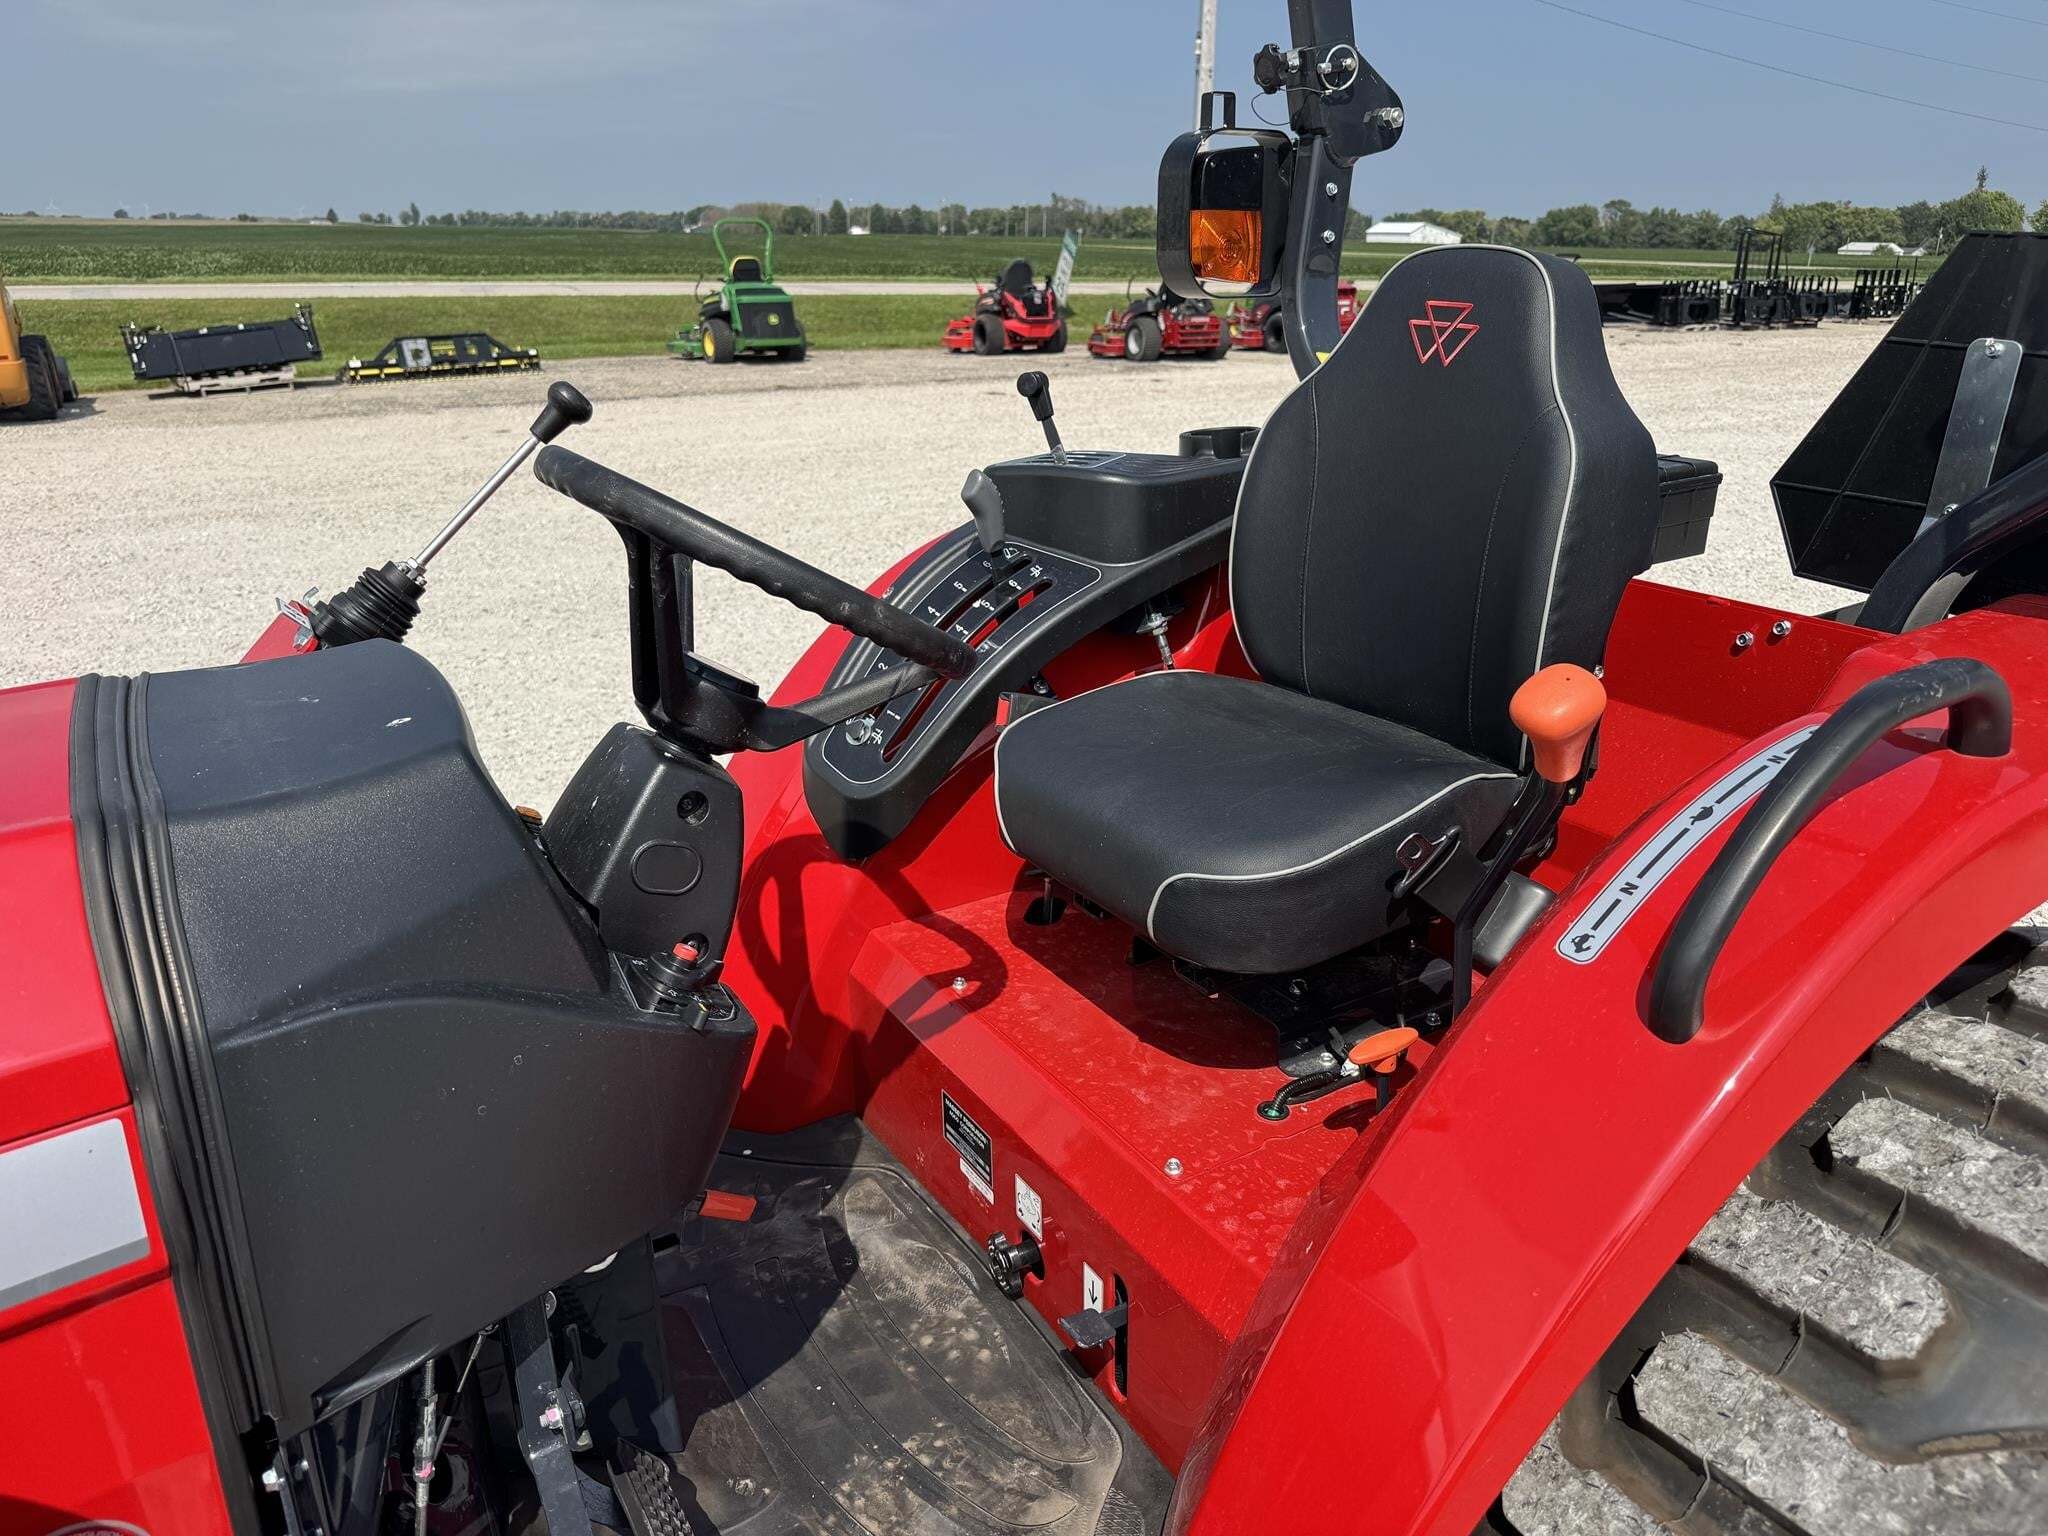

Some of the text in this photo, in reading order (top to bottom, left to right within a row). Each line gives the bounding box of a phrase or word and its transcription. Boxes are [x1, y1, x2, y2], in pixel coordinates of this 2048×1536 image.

[953, 581, 963, 590] 5
[1008, 579, 1018, 588] 6
[980, 599, 991, 608] 5
[927, 605, 936, 614] 4
[955, 623, 964, 632] 4
[878, 662, 889, 671] 2
[1767, 755, 1787, 765] N
[1619, 881, 1640, 896] N
